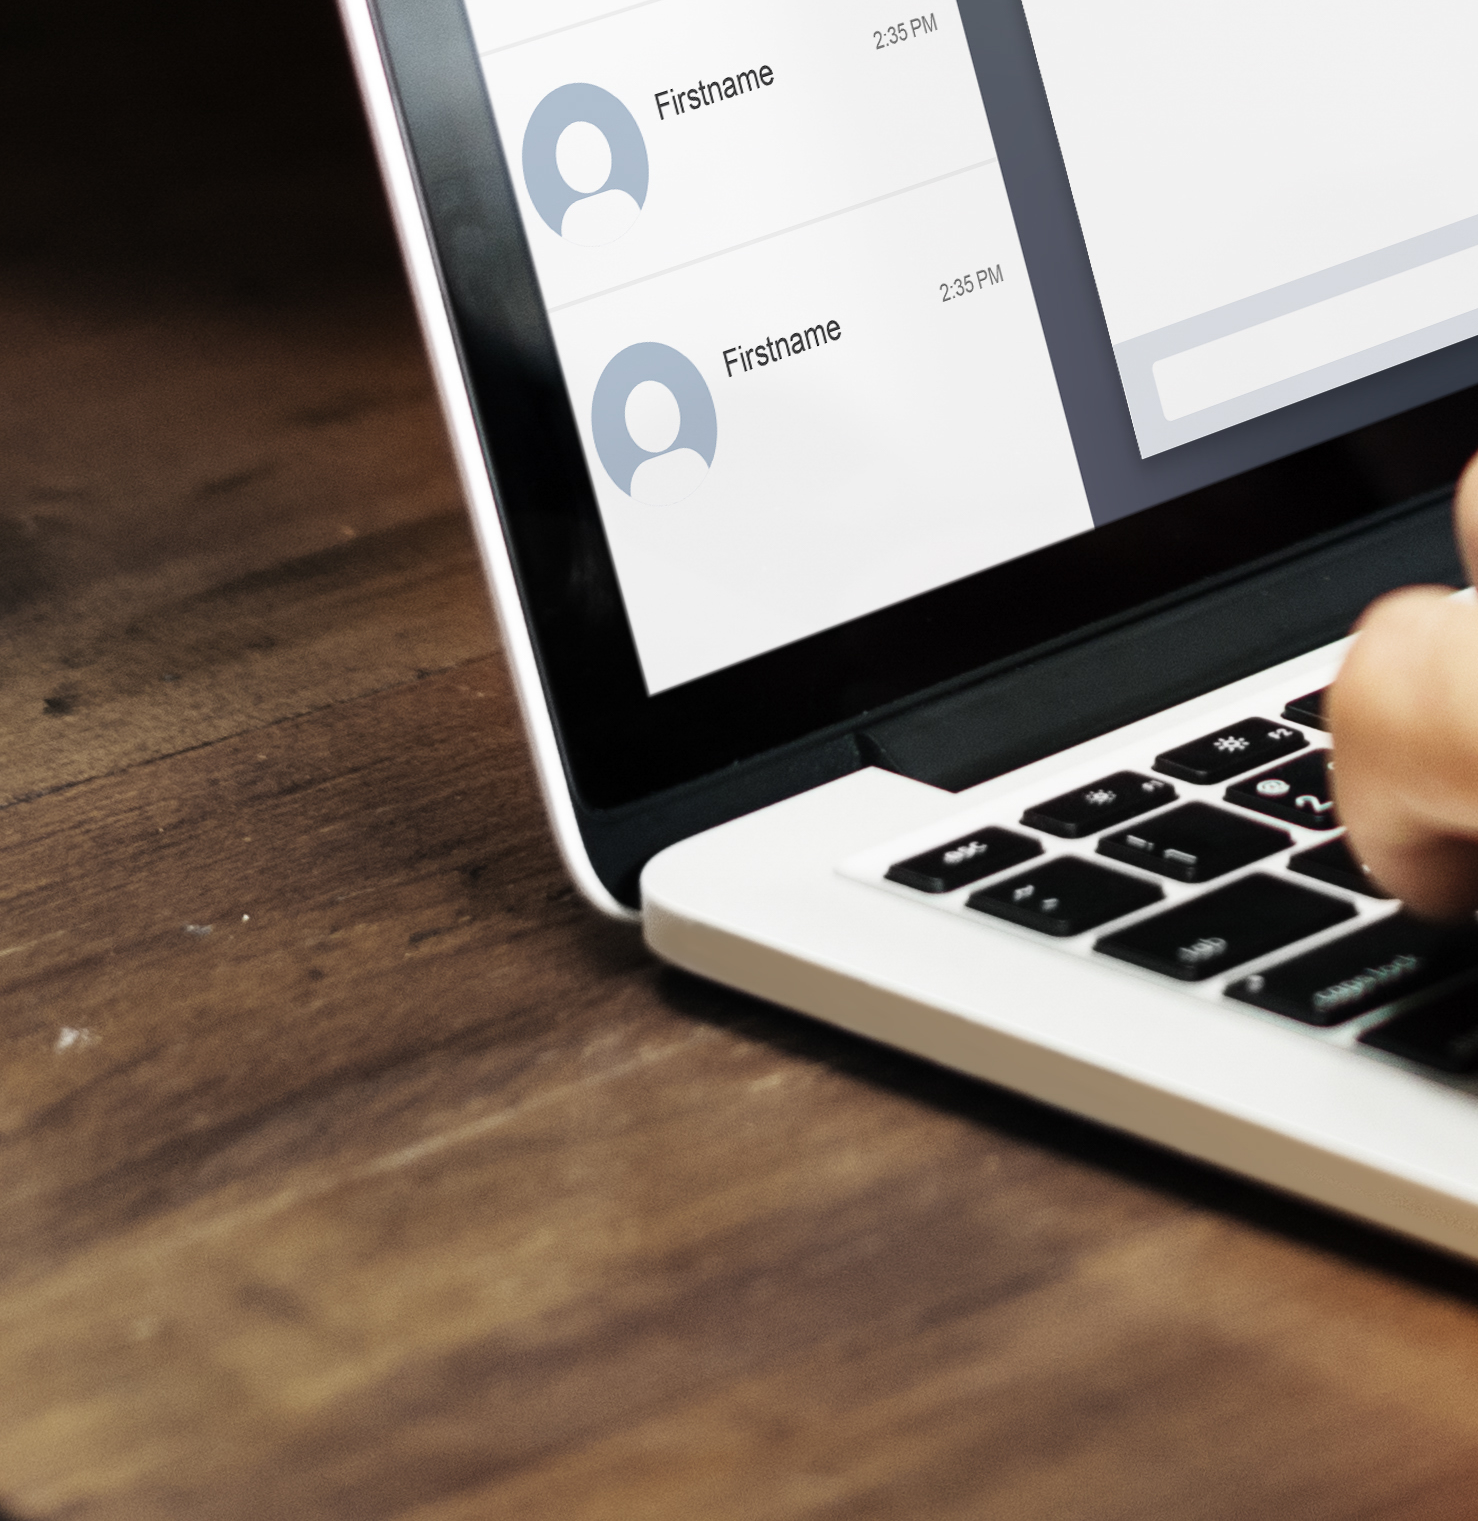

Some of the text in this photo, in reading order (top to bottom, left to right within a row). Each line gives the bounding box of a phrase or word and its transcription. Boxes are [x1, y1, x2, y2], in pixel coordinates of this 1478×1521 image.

[873, 12, 938, 50] 2:35 PM
[654, 63, 775, 121] Firstname
[939, 263, 1004, 303] 2:35 PM
[722, 319, 842, 378] Firstname
